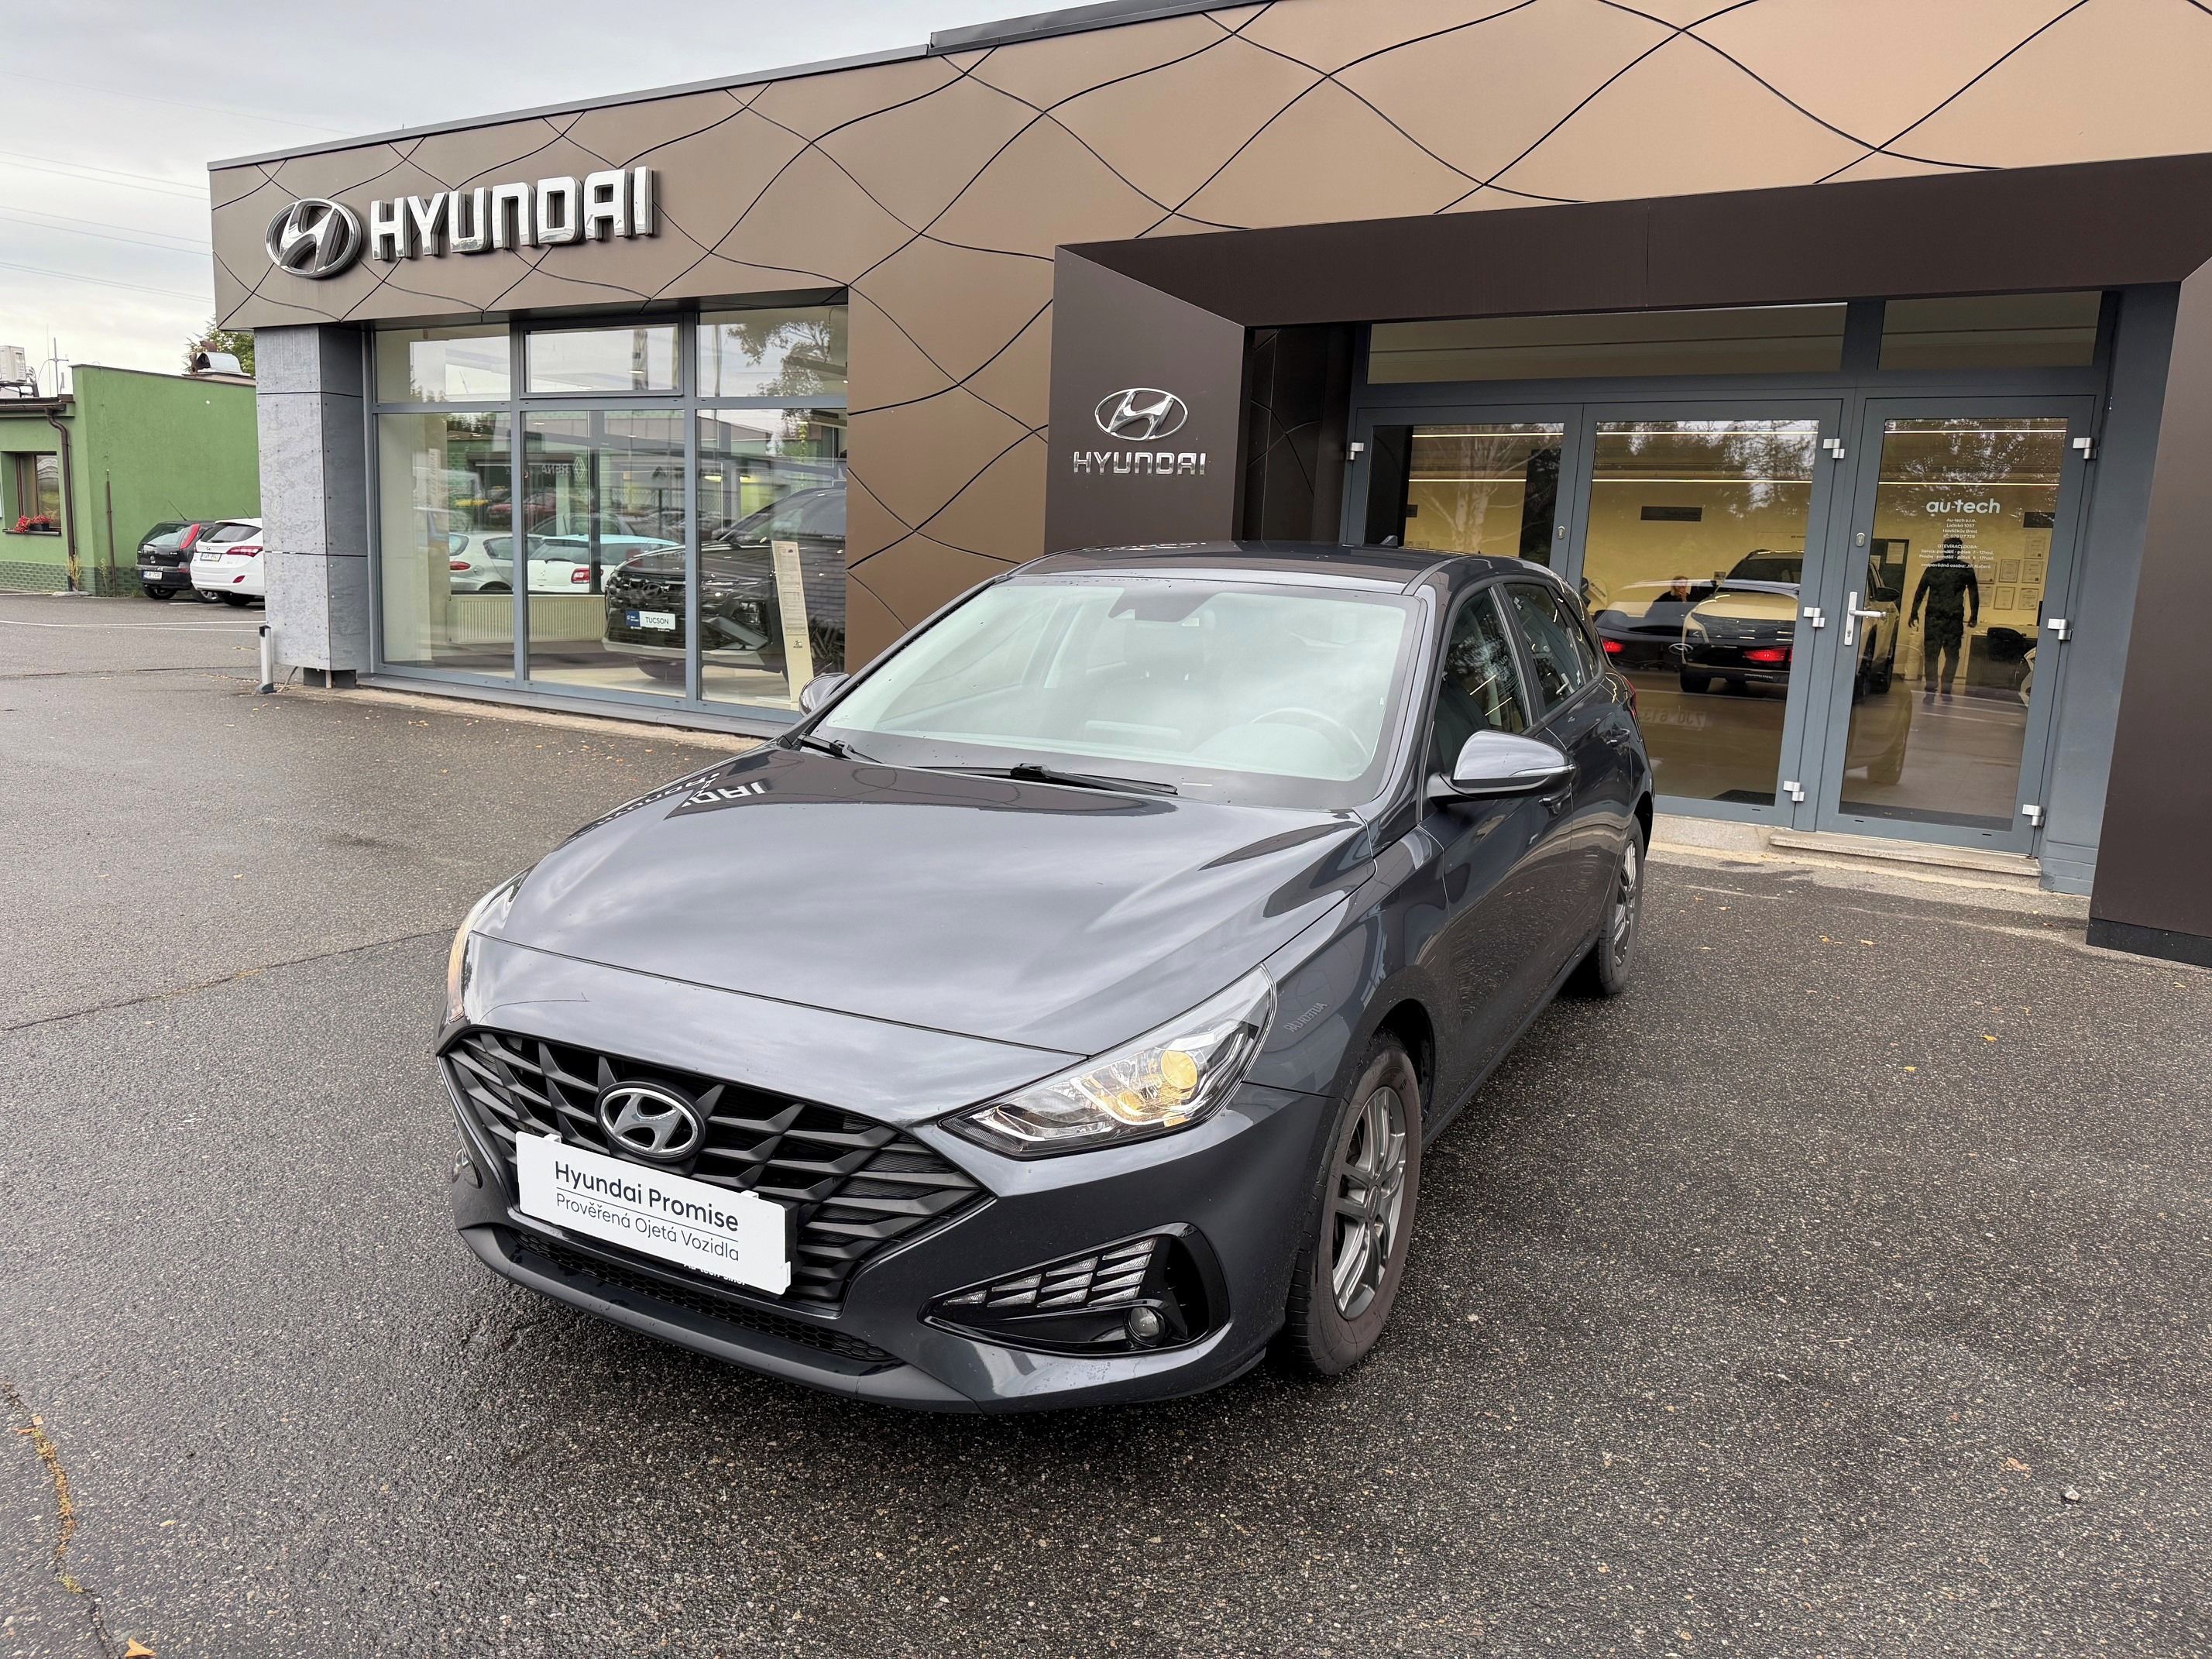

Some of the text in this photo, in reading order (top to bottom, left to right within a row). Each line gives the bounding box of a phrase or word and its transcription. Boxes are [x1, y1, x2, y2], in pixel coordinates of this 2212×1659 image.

[370, 165, 654, 262] HYUNDAI
[1073, 452, 1207, 476] HYUNDAI
[1925, 498, 2001, 514] au-tech
[555, 1161, 739, 1232] Hyundai Promise
[556, 1193, 739, 1262] Prověřená Ojetá Vozidla
